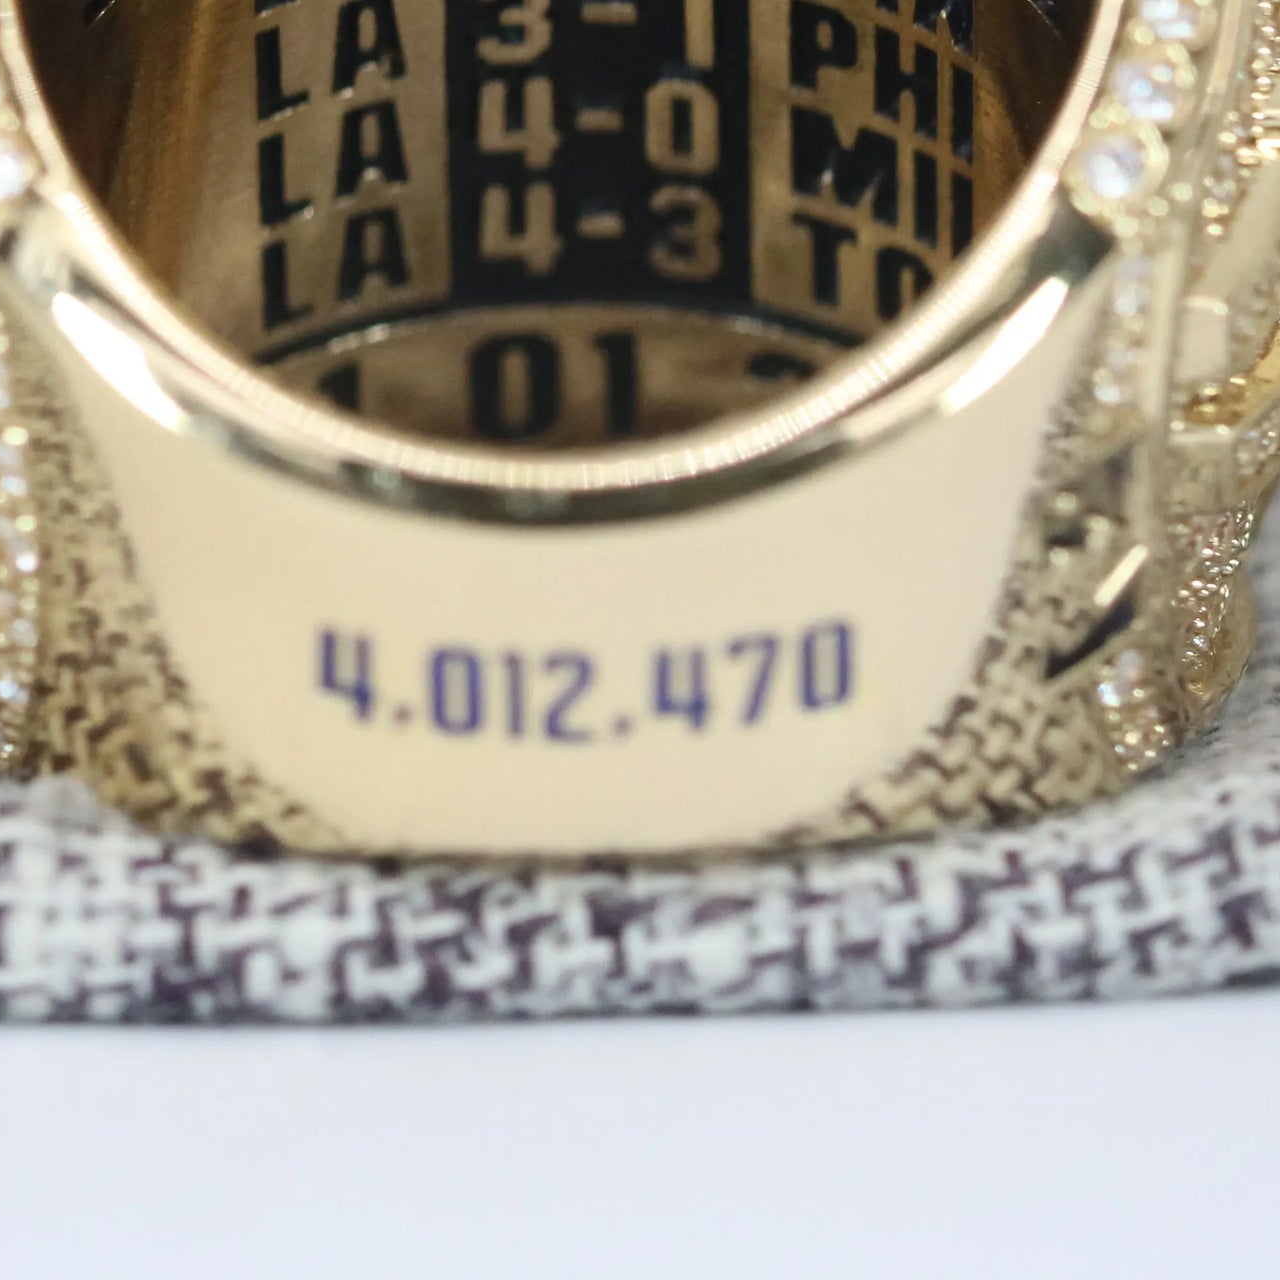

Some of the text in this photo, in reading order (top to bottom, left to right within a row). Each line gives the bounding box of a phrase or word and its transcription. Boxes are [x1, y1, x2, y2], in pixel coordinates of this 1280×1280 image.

[258, 102, 409, 226] LA
[478, 77, 719, 175] 4-0
[262, 210, 411, 332] LA
[479, 183, 722, 283] 4-3
[317, 620, 852, 744] 4.012.470
